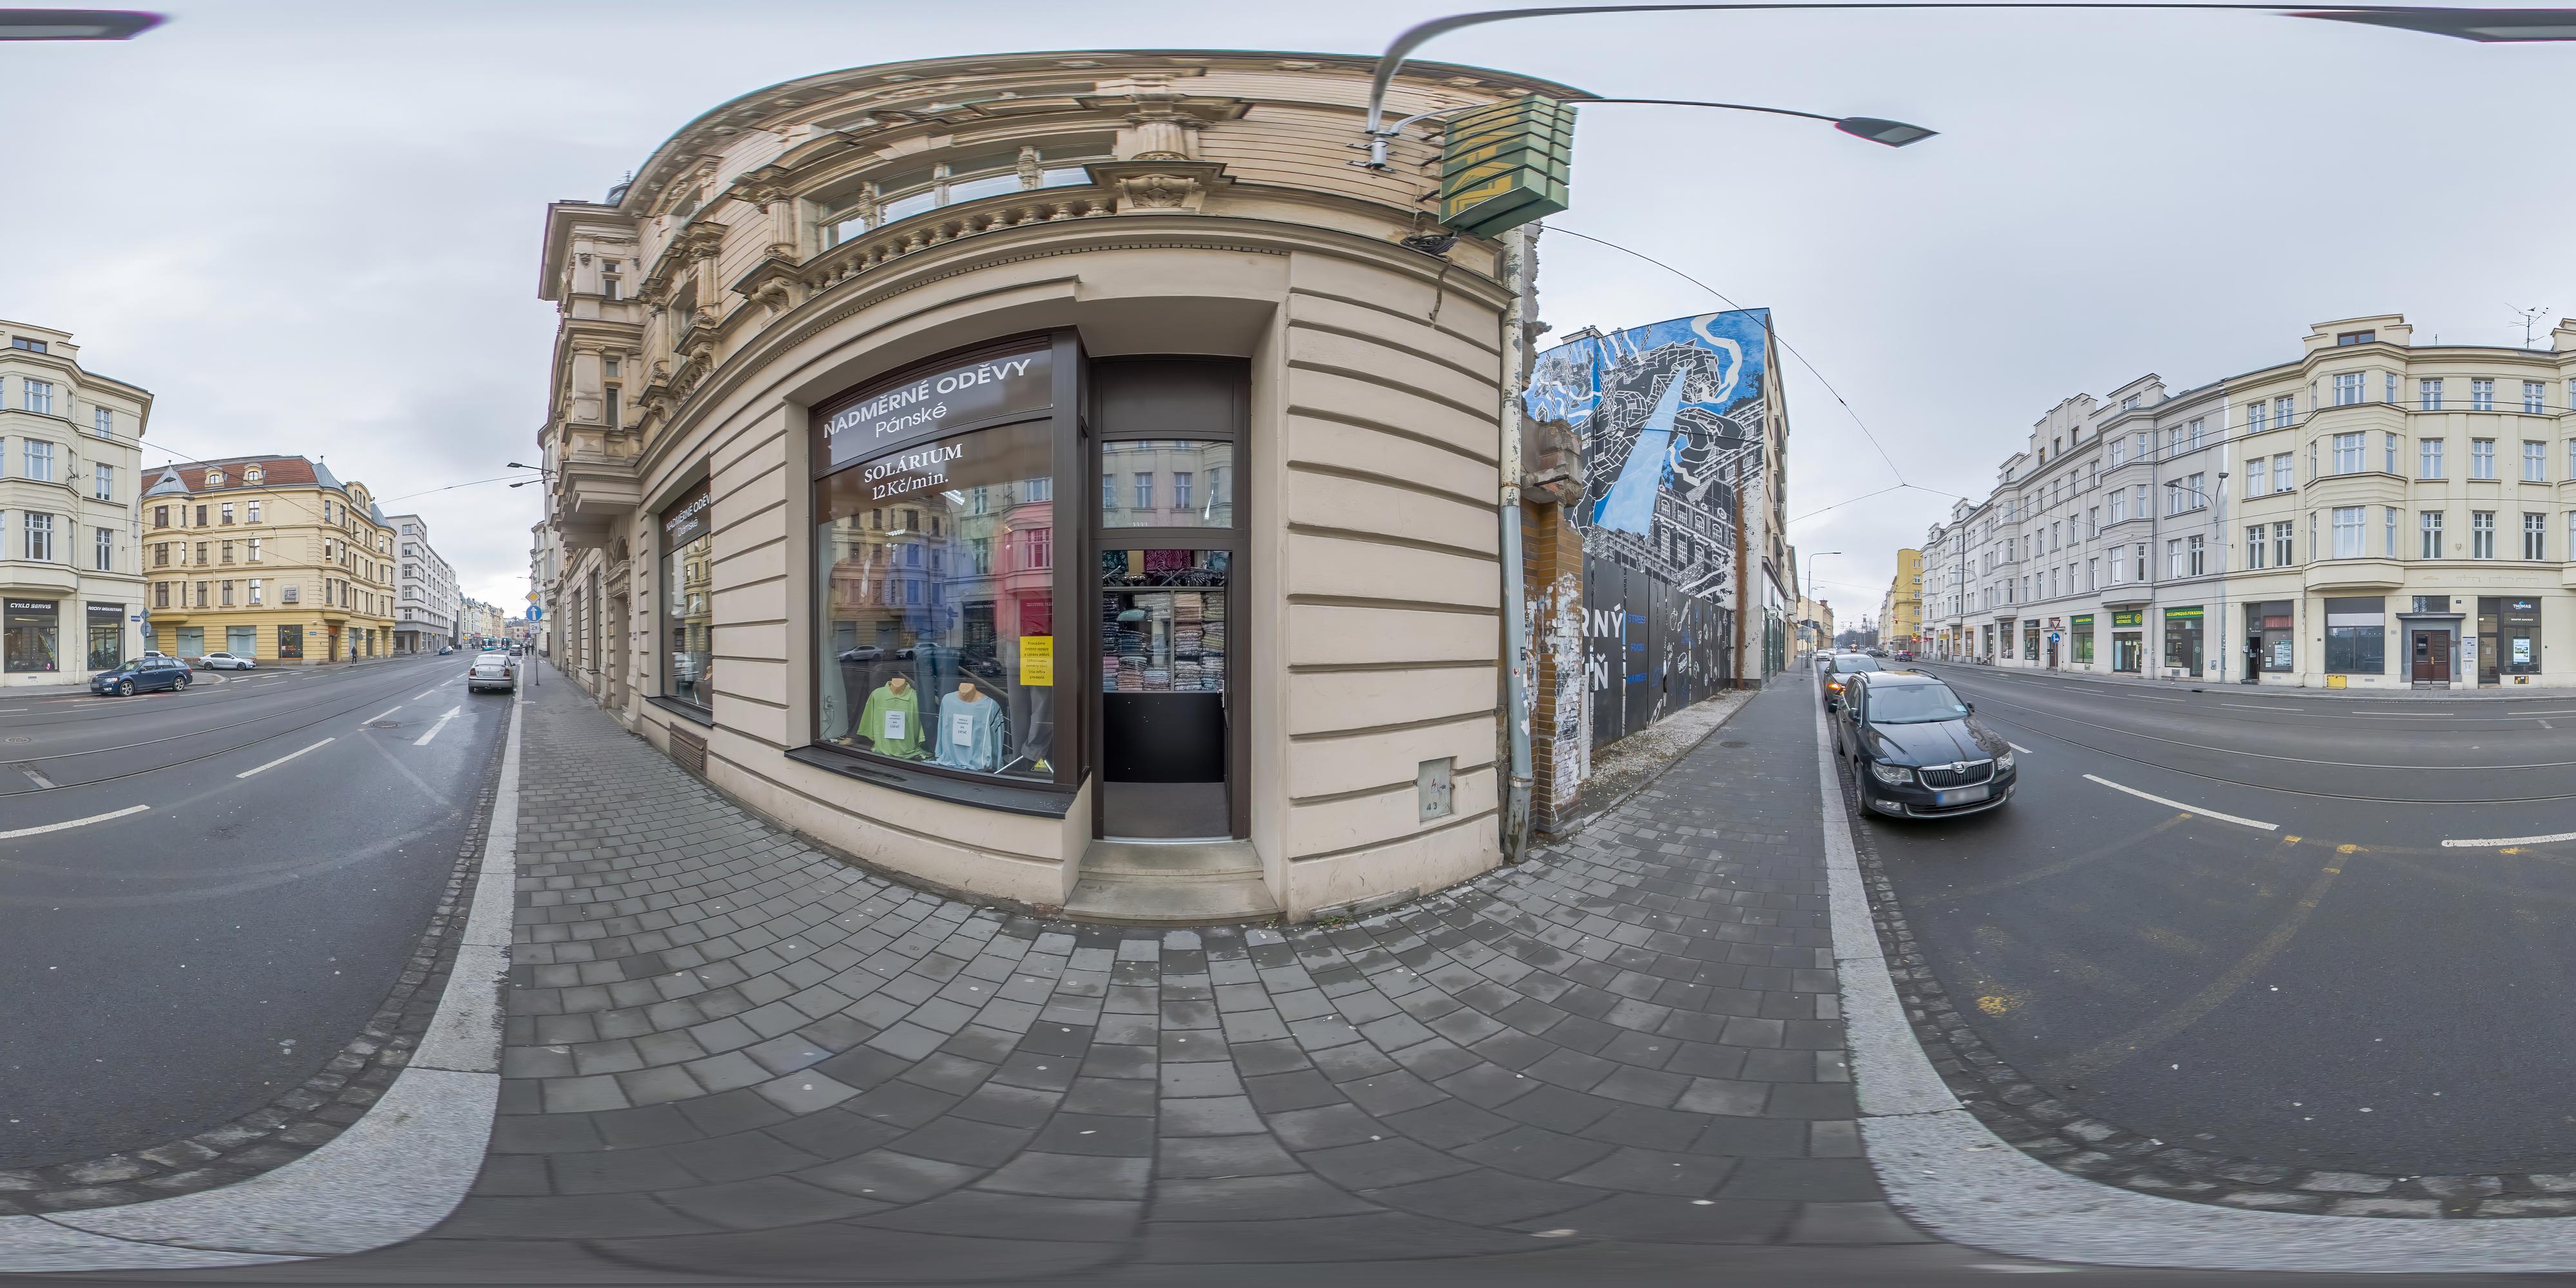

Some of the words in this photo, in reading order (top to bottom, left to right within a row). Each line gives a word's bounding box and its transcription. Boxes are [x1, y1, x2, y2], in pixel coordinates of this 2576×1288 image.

[824, 379, 929, 439] NADMĚRNÉ
[936, 359, 1031, 394] ODĚVY
[876, 401, 947, 438] Pánské
[864, 443, 963, 483] SOLÁRIUM
[1628, 614, 1647, 624] STREET
[1631, 643, 1644, 652] FOOD
[1426, 802, 1437, 811] 43
